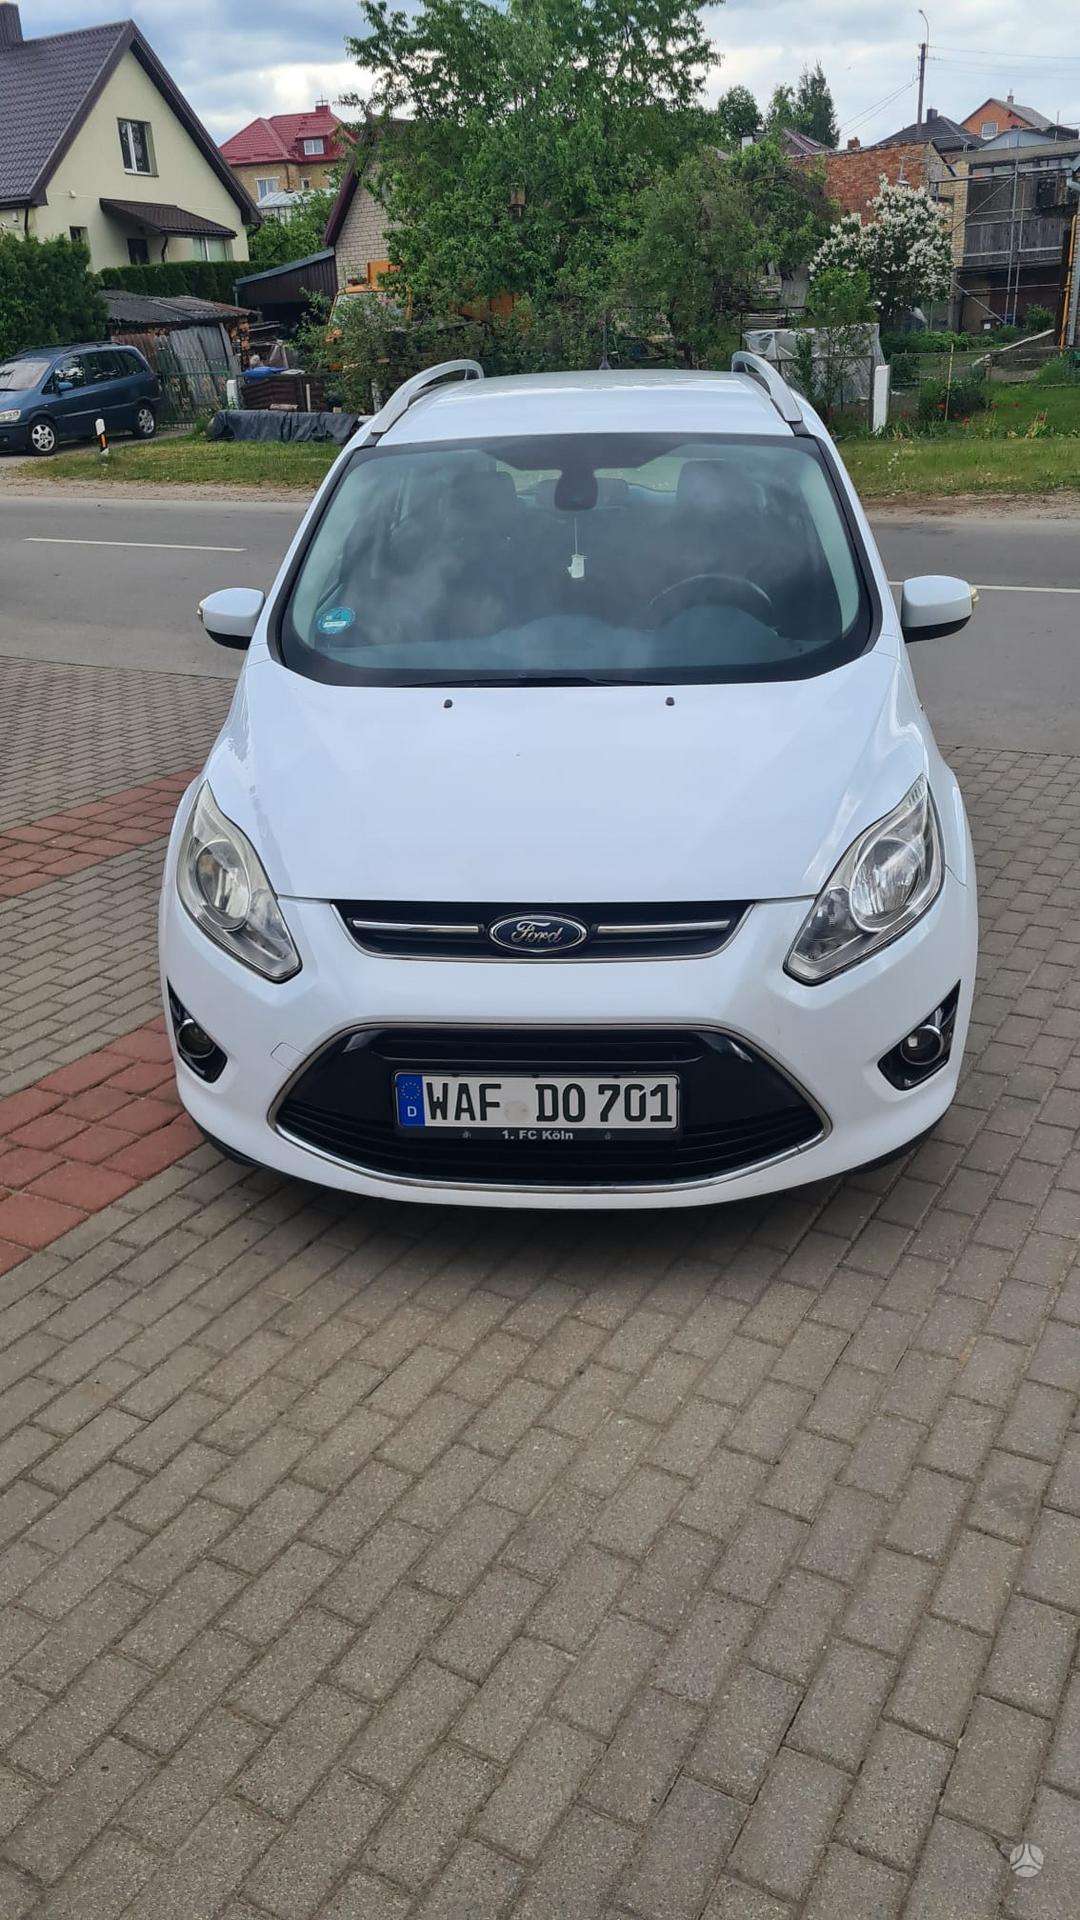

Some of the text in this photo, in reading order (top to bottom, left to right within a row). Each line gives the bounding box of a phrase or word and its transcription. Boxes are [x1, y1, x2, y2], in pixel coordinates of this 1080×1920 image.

[511, 920, 564, 943] Ford
[426, 1082, 673, 1123] WAF DO 701
[407, 1106, 417, 1117] D
[501, 1130, 574, 1141] 1. FC Köln
